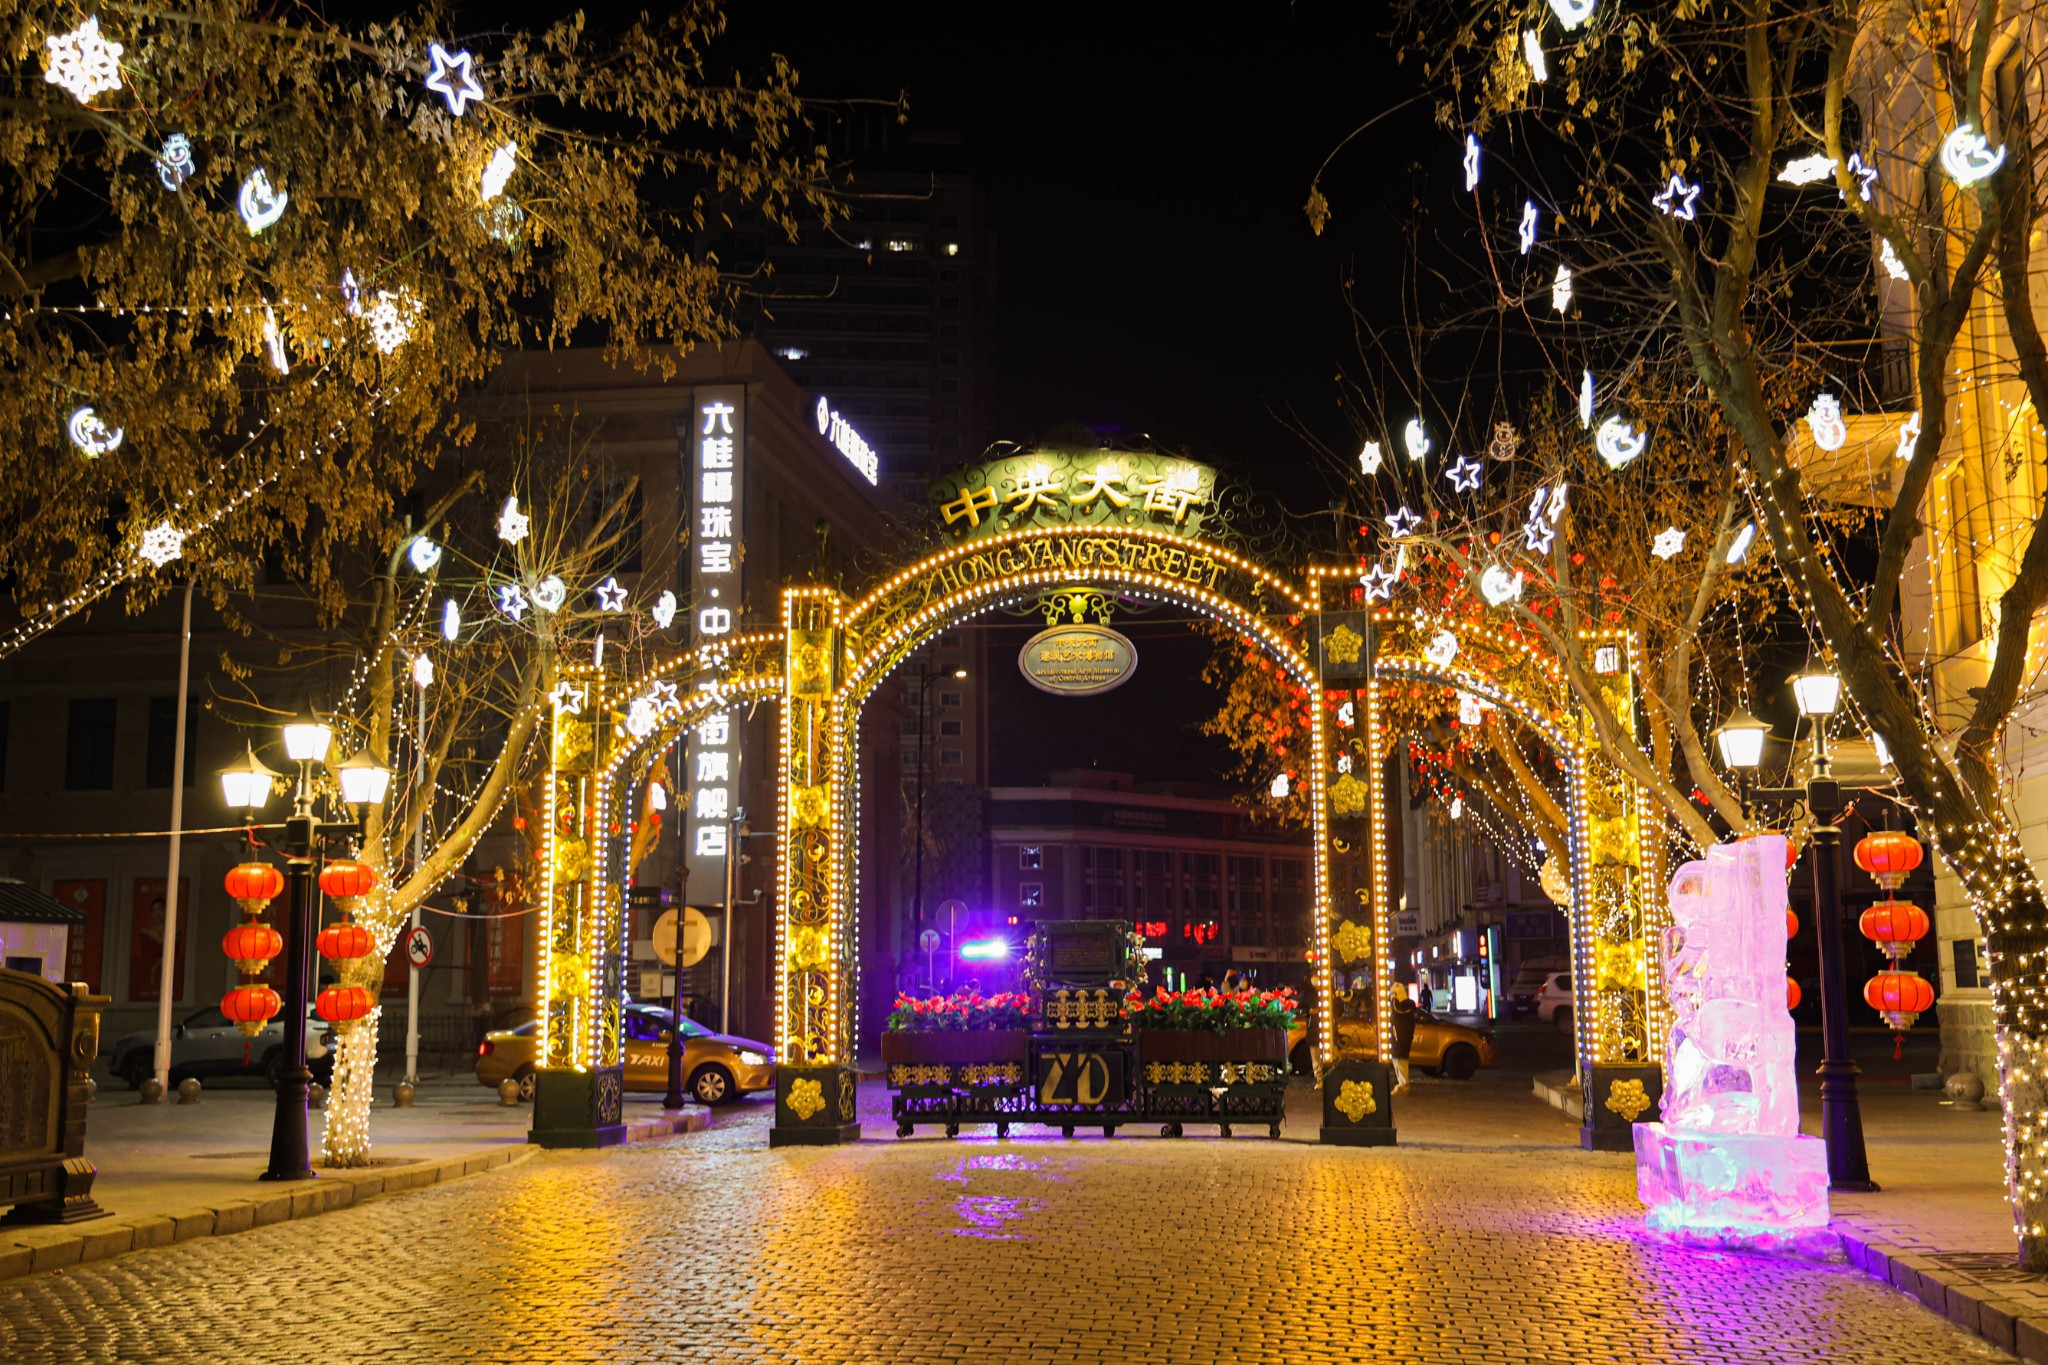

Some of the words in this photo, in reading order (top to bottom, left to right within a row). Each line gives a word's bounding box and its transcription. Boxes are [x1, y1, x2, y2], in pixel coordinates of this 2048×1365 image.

[939, 464, 1203, 527] 中央大街
[1055, 635, 1099, 649] 中央大街
[628, 1053, 665, 1066] TAXI
